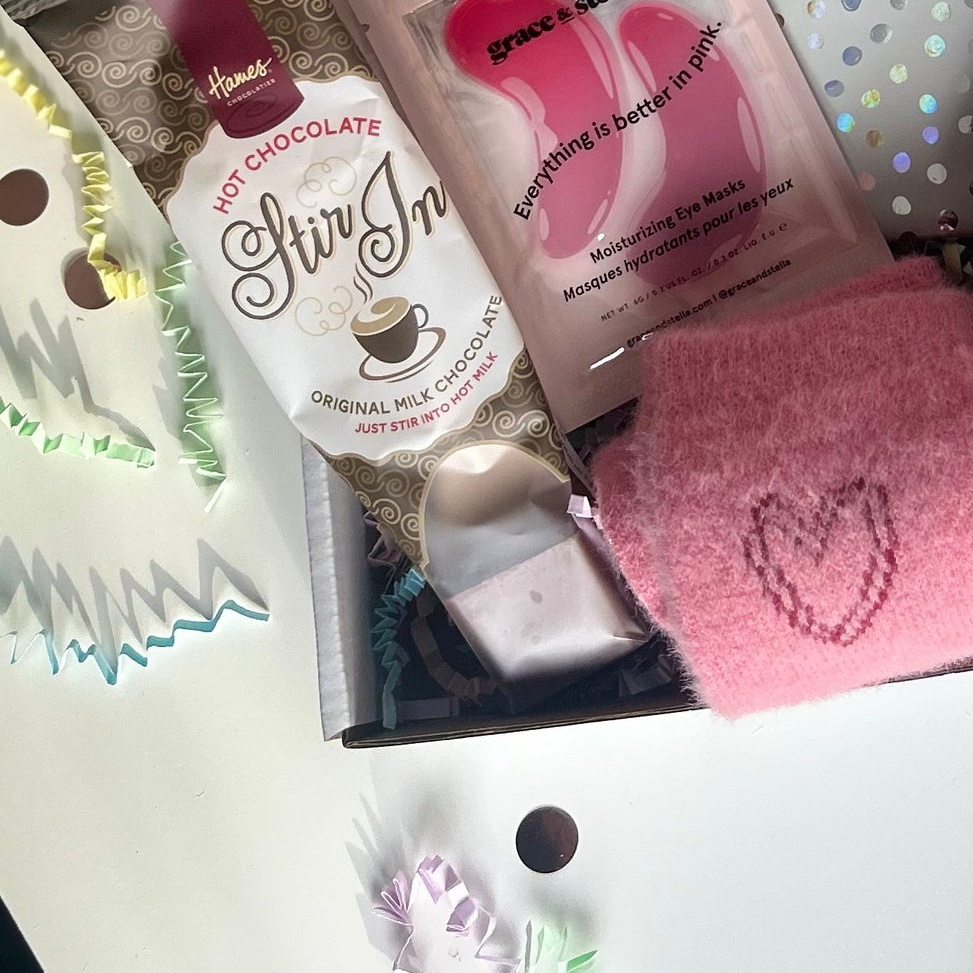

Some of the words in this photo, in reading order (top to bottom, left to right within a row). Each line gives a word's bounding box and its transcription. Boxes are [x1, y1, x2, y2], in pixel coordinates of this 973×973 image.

[486, 12, 556, 65] grace
[557, 5, 575, 26] &
[208, 57, 273, 100] Hames
[227, 78, 276, 107] CHOCOLATIER
[513, 126, 596, 221] Everything
[594, 119, 612, 140] is
[612, 87, 672, 133] better
[669, 67, 692, 92] in
[688, 21, 723, 74] pink.
[212, 169, 247, 215] HOT
[244, 116, 383, 172] CHOCOLATE
[221, 191, 355, 320] Stir
[357, 150, 447, 278] In
[563, 263, 623, 303] Masques
[623, 225, 701, 274] hydratants
[701, 205, 737, 237] pour
[736, 195, 760, 219] les
[758, 176, 795, 207] yeux
[590, 214, 676, 265] Moisturizing
[675, 198, 702, 225] Eye
[702, 177, 746, 207] Masks
[600, 310, 616, 322] NET
[718, 257, 792, 300] @graceandstella
[310, 389, 391, 416] ORIGINAL
[394, 387, 435, 413] MILK
[434, 294, 503, 394] CHOCOLATE
[354, 421, 388, 435] JUST
[390, 416, 420, 433] STIR
[420, 401, 451, 426] INTO
[449, 376, 476, 407] HOT
[472, 350, 499, 382] MILK
